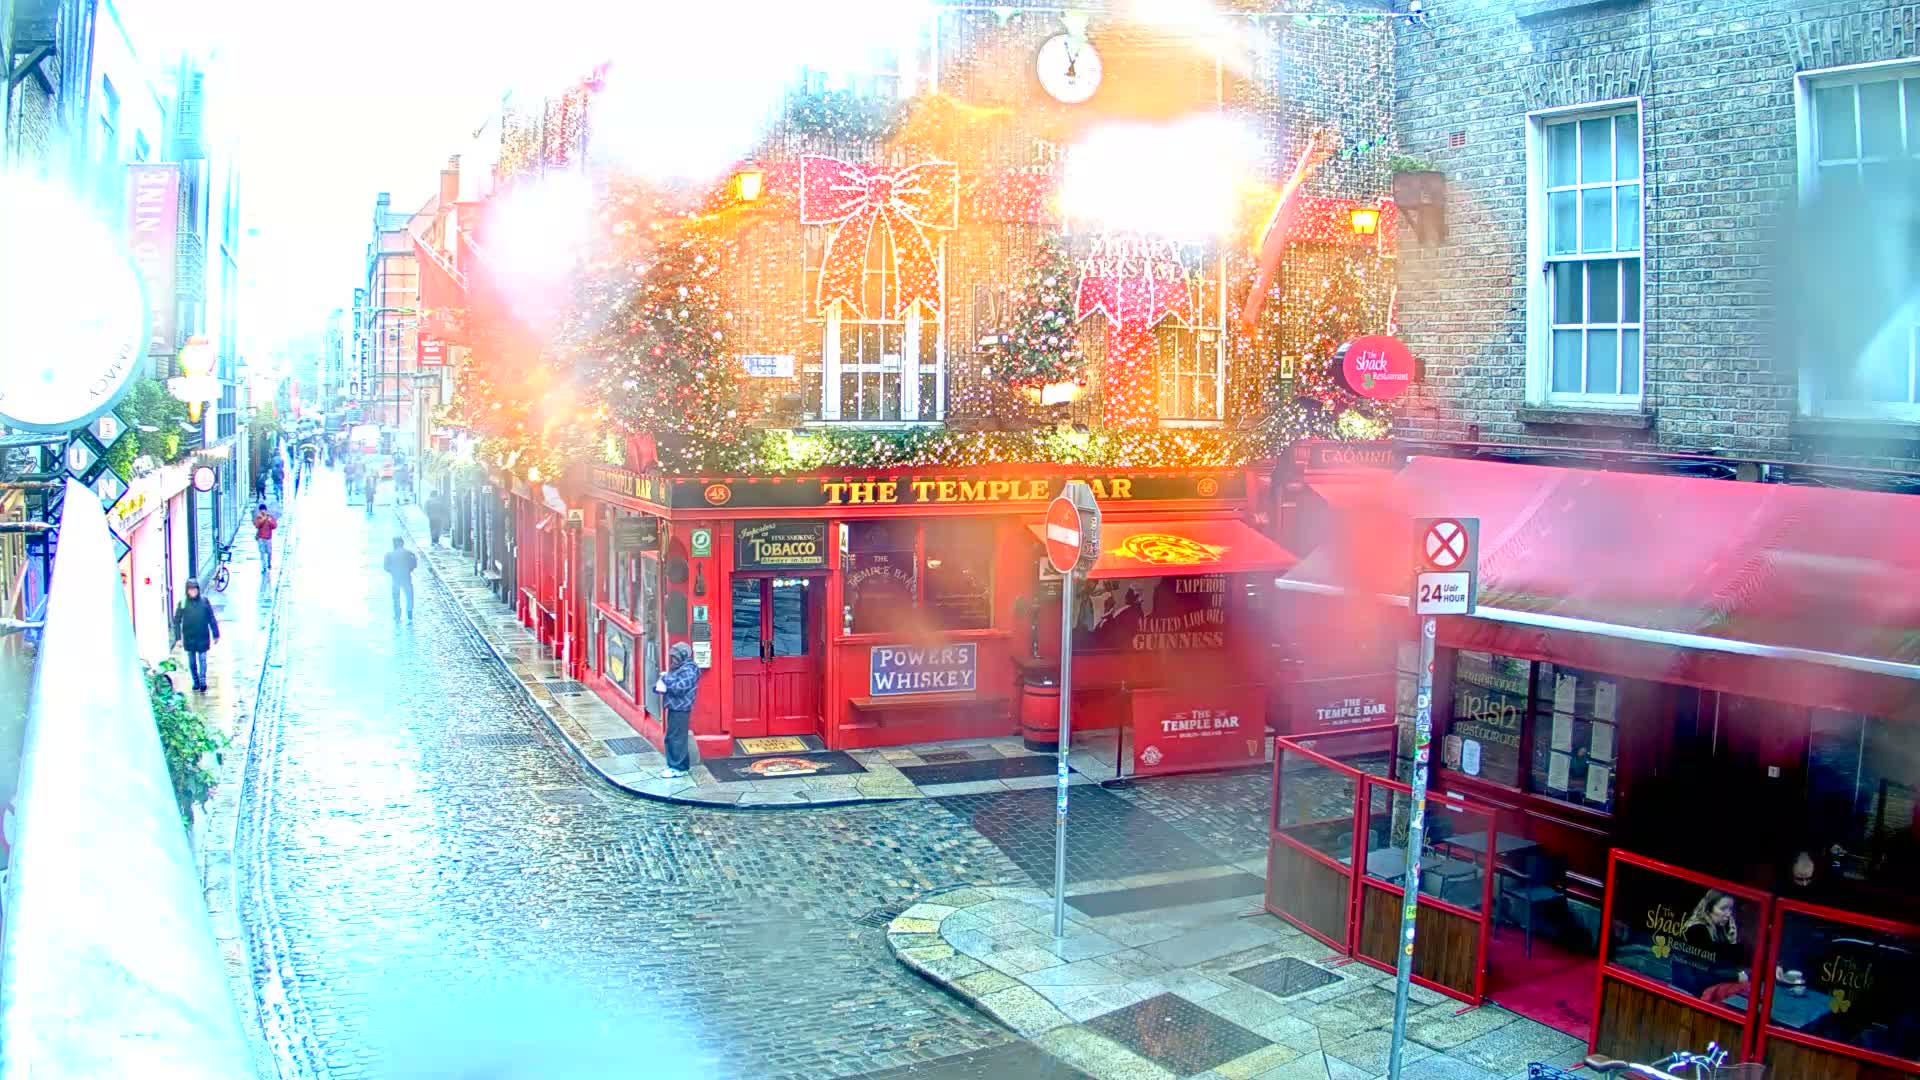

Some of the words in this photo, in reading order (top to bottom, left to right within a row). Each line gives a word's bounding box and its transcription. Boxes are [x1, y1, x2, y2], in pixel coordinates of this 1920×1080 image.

[1356, 350, 1388, 373] Shack
[635, 477, 652, 500] BAR
[823, 482, 898, 503] THE
[912, 480, 1049, 502] TEMPLE
[751, 539, 815, 561] TOBACCO
[1176, 578, 1225, 593] EMPEROR
[1420, 584, 1442, 602] 24
[1443, 584, 1459, 592] Uair
[1132, 632, 1224, 650] GUINNESS
[880, 648, 968, 667] POWER'S
[874, 670, 973, 690] WHISKEY
[1344, 698, 1360, 706] THE
[1192, 710, 1210, 719] THE
[1317, 706, 1360, 720] TEMPLE
[1363, 703, 1386, 715] BAR
[1161, 719, 1210, 732] TEMPLE
[1214, 716, 1239, 728] BAR
[1646, 904, 1688, 942] Shack
[1668, 937, 1716, 963] Restaurant
